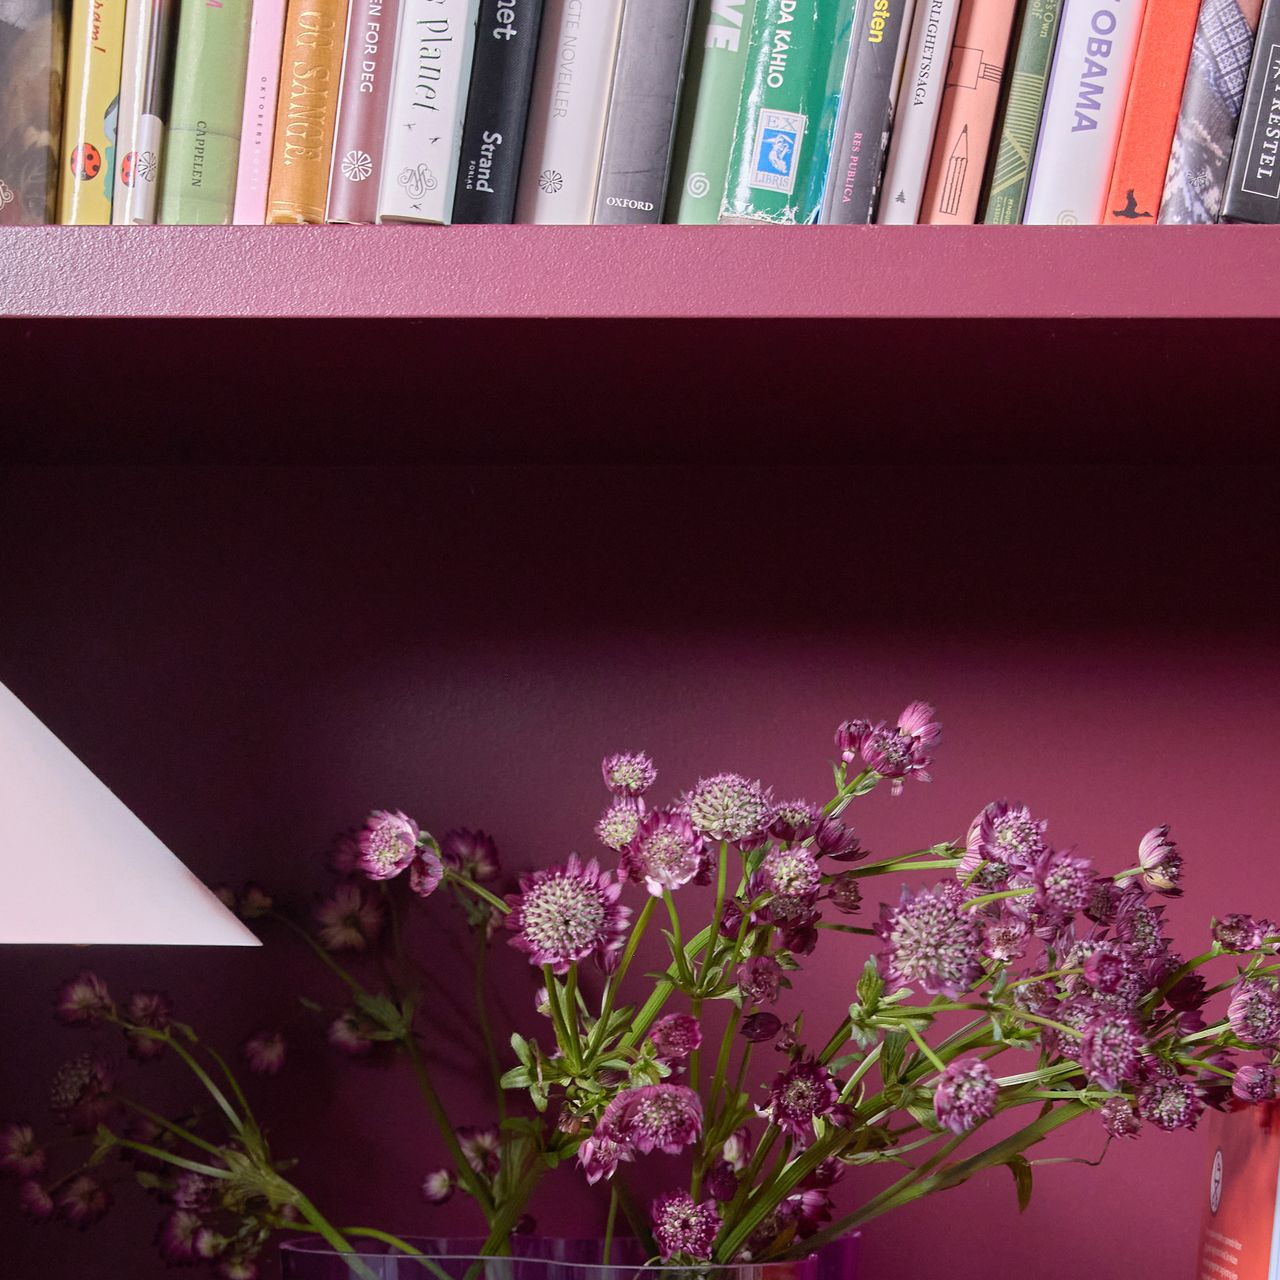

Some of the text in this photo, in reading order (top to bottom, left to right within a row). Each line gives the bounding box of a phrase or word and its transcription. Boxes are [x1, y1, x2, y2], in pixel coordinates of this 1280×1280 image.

[364, 22, 380, 55] FOR
[1039, 12, 1054, 38] Own
[360, 61, 375, 93] DEG
[412, 18, 453, 112] planet
[553, 36, 579, 119] NOVELLER
[767, 30, 793, 88] KAHLO
[1071, 10, 1117, 133] OBAMA
[765, 114, 798, 132] EX
[192, 121, 207, 187] CAPPELEN
[476, 130, 503, 194] Strand
[754, 172, 790, 188] LIBRIS
[843, 132, 863, 204] RES PUBLICA
[606, 196, 654, 212] OXFORD
